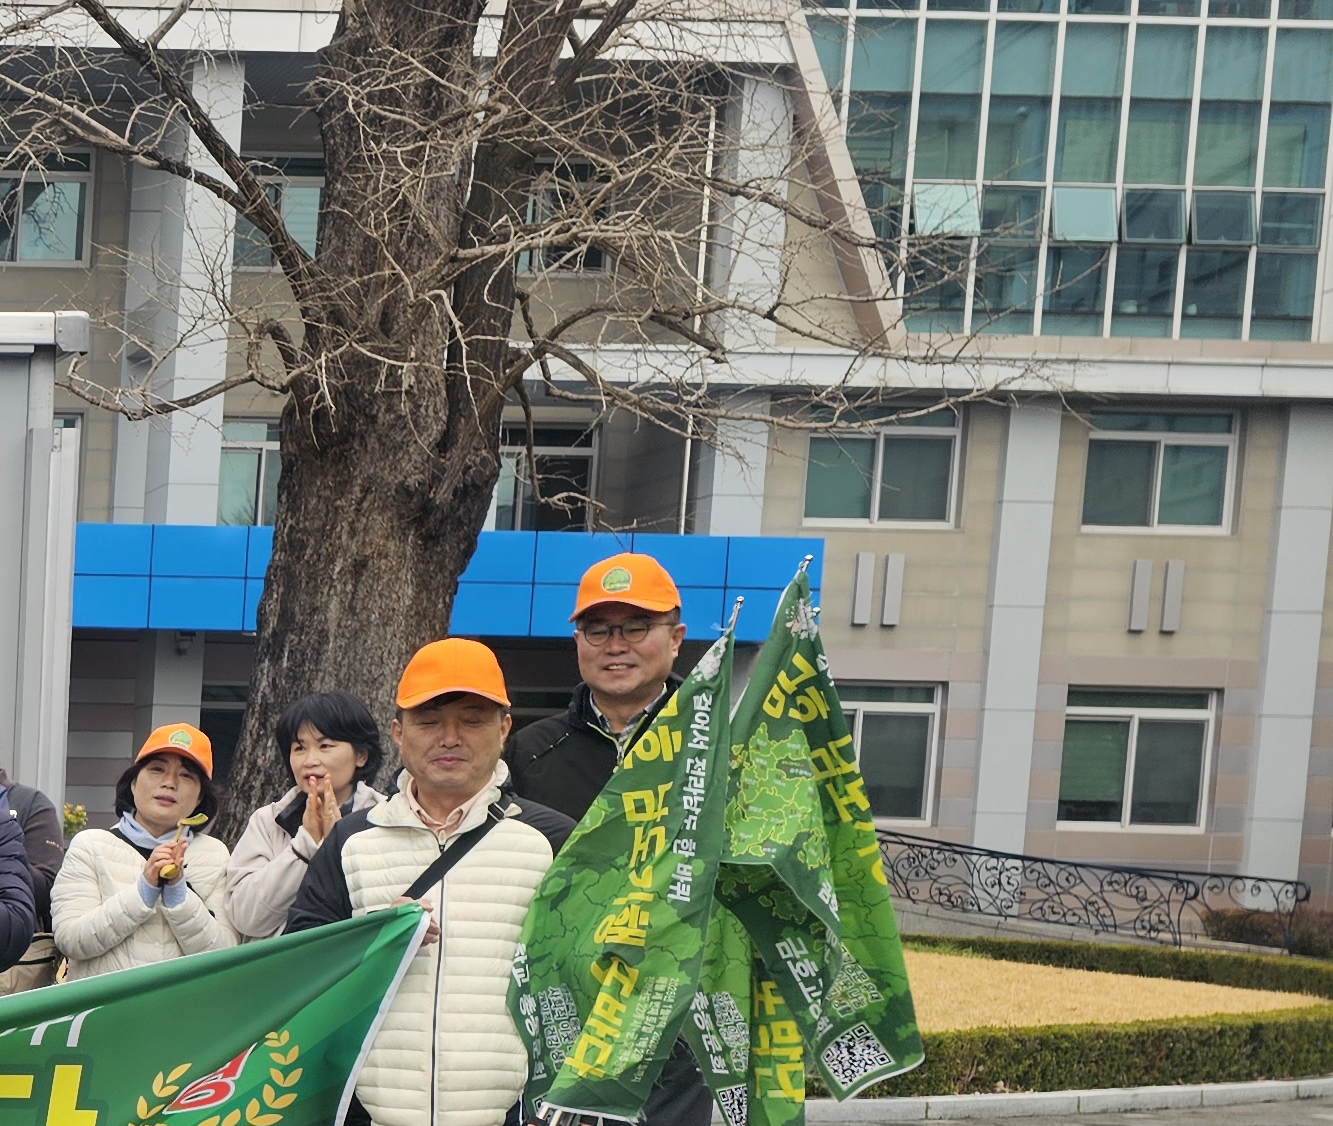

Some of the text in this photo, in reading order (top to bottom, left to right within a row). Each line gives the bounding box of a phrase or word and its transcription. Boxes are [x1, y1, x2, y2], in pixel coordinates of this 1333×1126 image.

[667, 693, 713, 903] 걸어서 전라남도 한 바퀴
